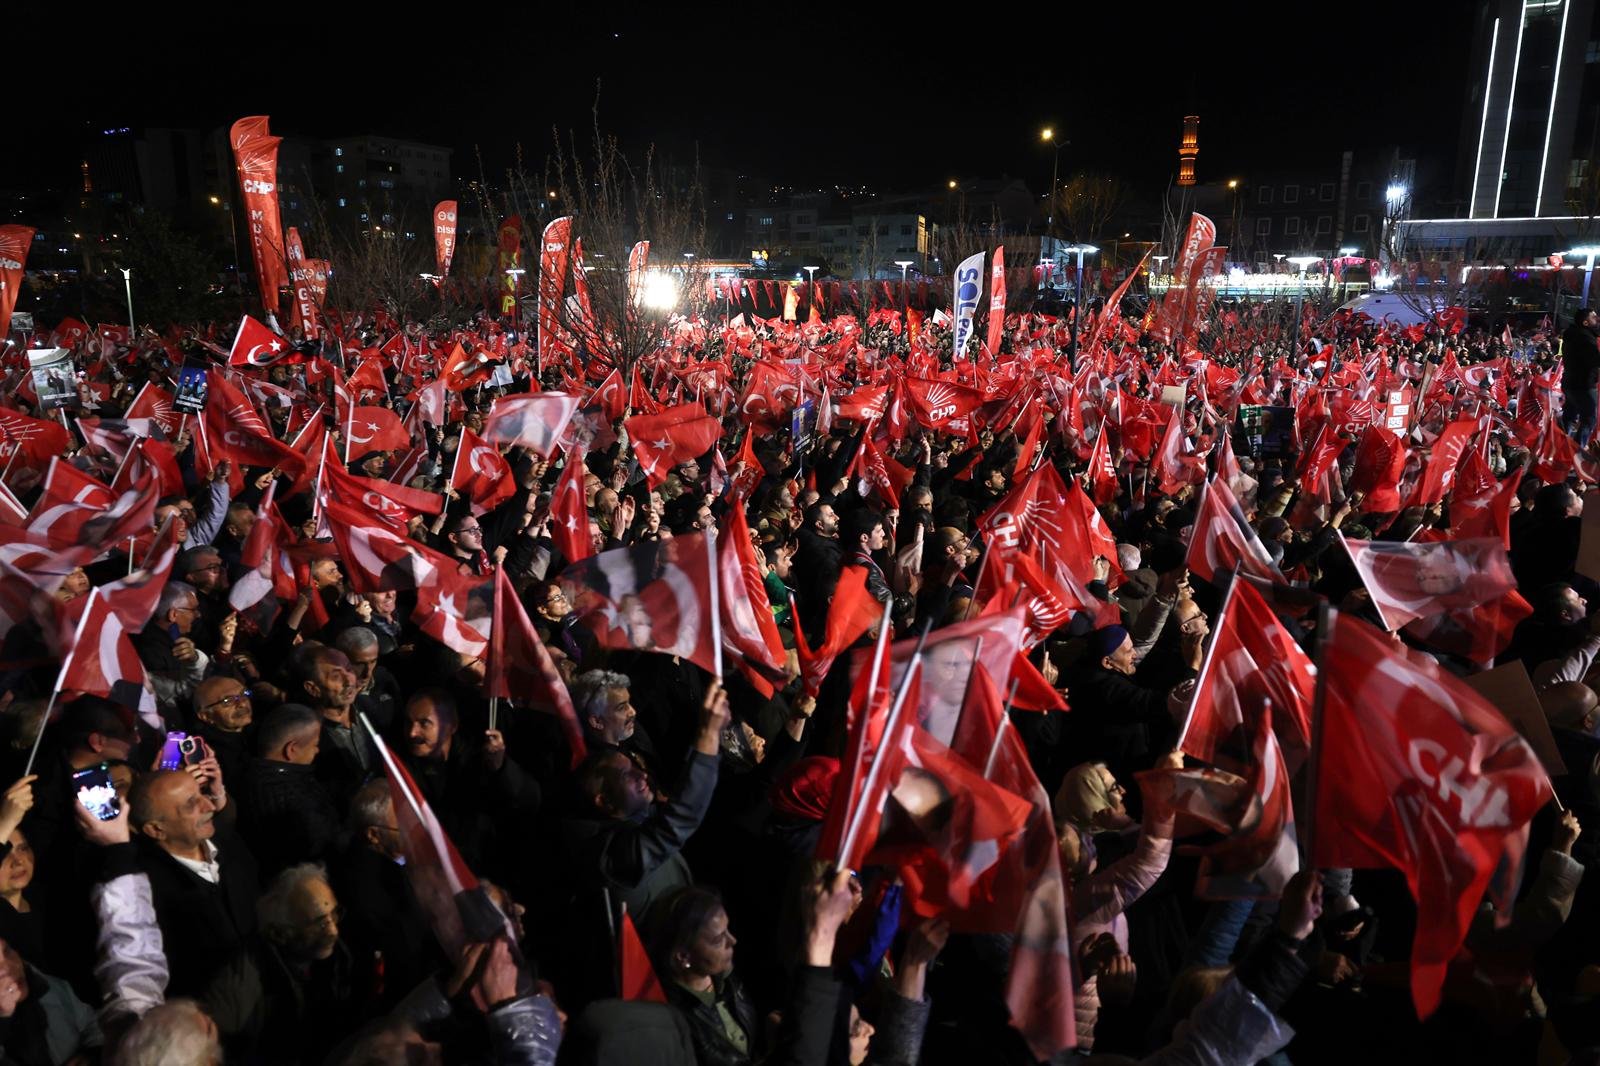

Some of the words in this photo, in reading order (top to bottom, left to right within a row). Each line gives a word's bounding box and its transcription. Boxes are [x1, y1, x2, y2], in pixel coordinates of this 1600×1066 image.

[243, 180, 274, 194] CHP
[930, 405, 956, 422] CHP
[156, 420, 173, 434] HP
[1345, 422, 1366, 433] CH
[993, 512, 1019, 558] CH
